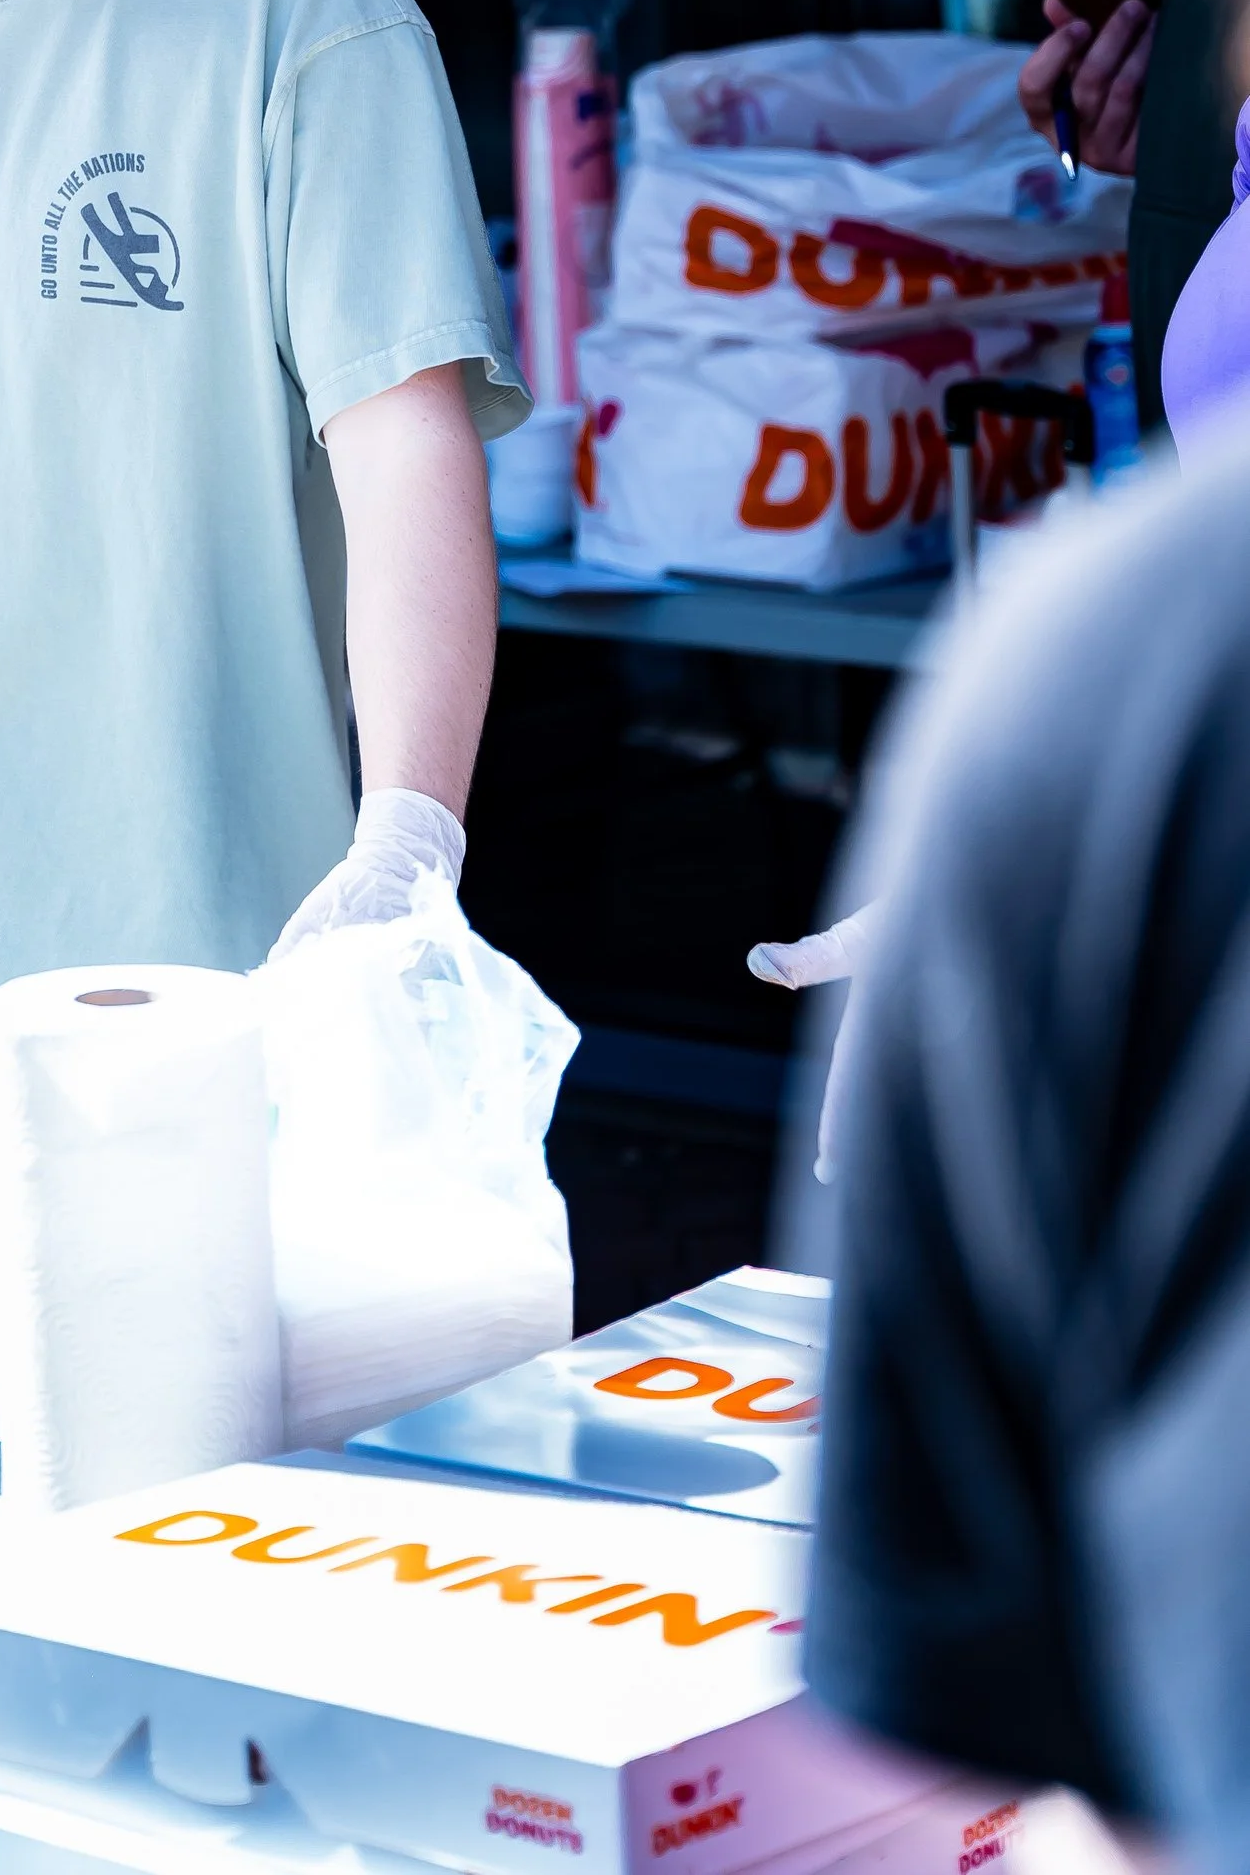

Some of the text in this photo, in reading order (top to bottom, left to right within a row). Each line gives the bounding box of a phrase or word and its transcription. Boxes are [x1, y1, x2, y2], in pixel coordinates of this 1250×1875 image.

[41, 152, 146, 300] GO UNTO ALL THE NATIONS
